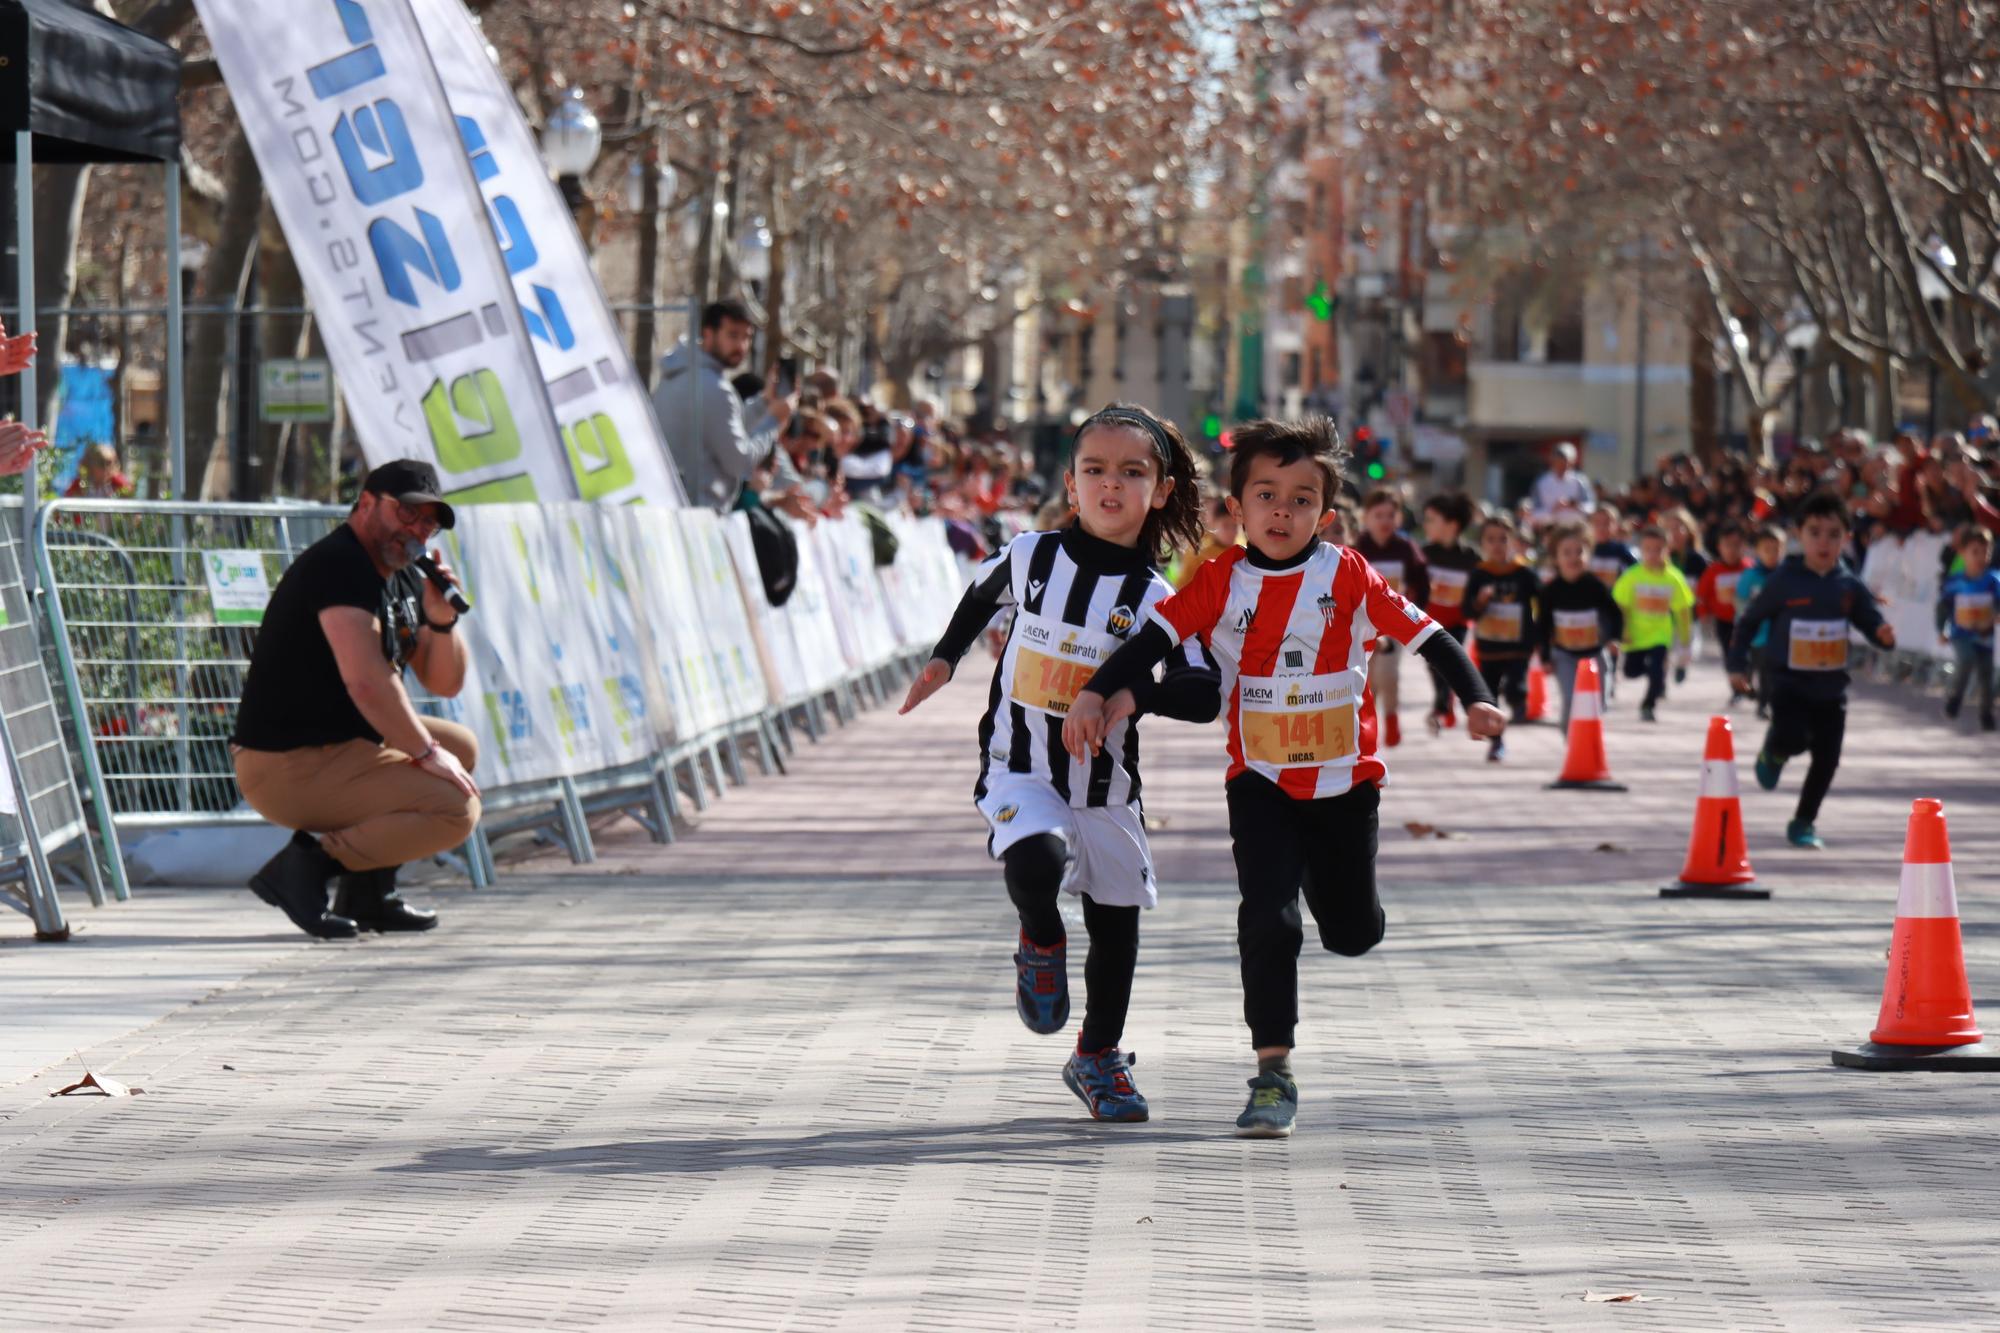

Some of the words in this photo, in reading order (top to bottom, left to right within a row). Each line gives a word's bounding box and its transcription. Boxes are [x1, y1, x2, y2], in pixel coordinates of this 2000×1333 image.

[1060, 641, 1097, 659] marató
[1242, 687, 1273, 699] SALERA
[1286, 690, 1324, 706] marató
[1271, 711, 1325, 748] 141
[1287, 751, 1315, 763] LUCAS
